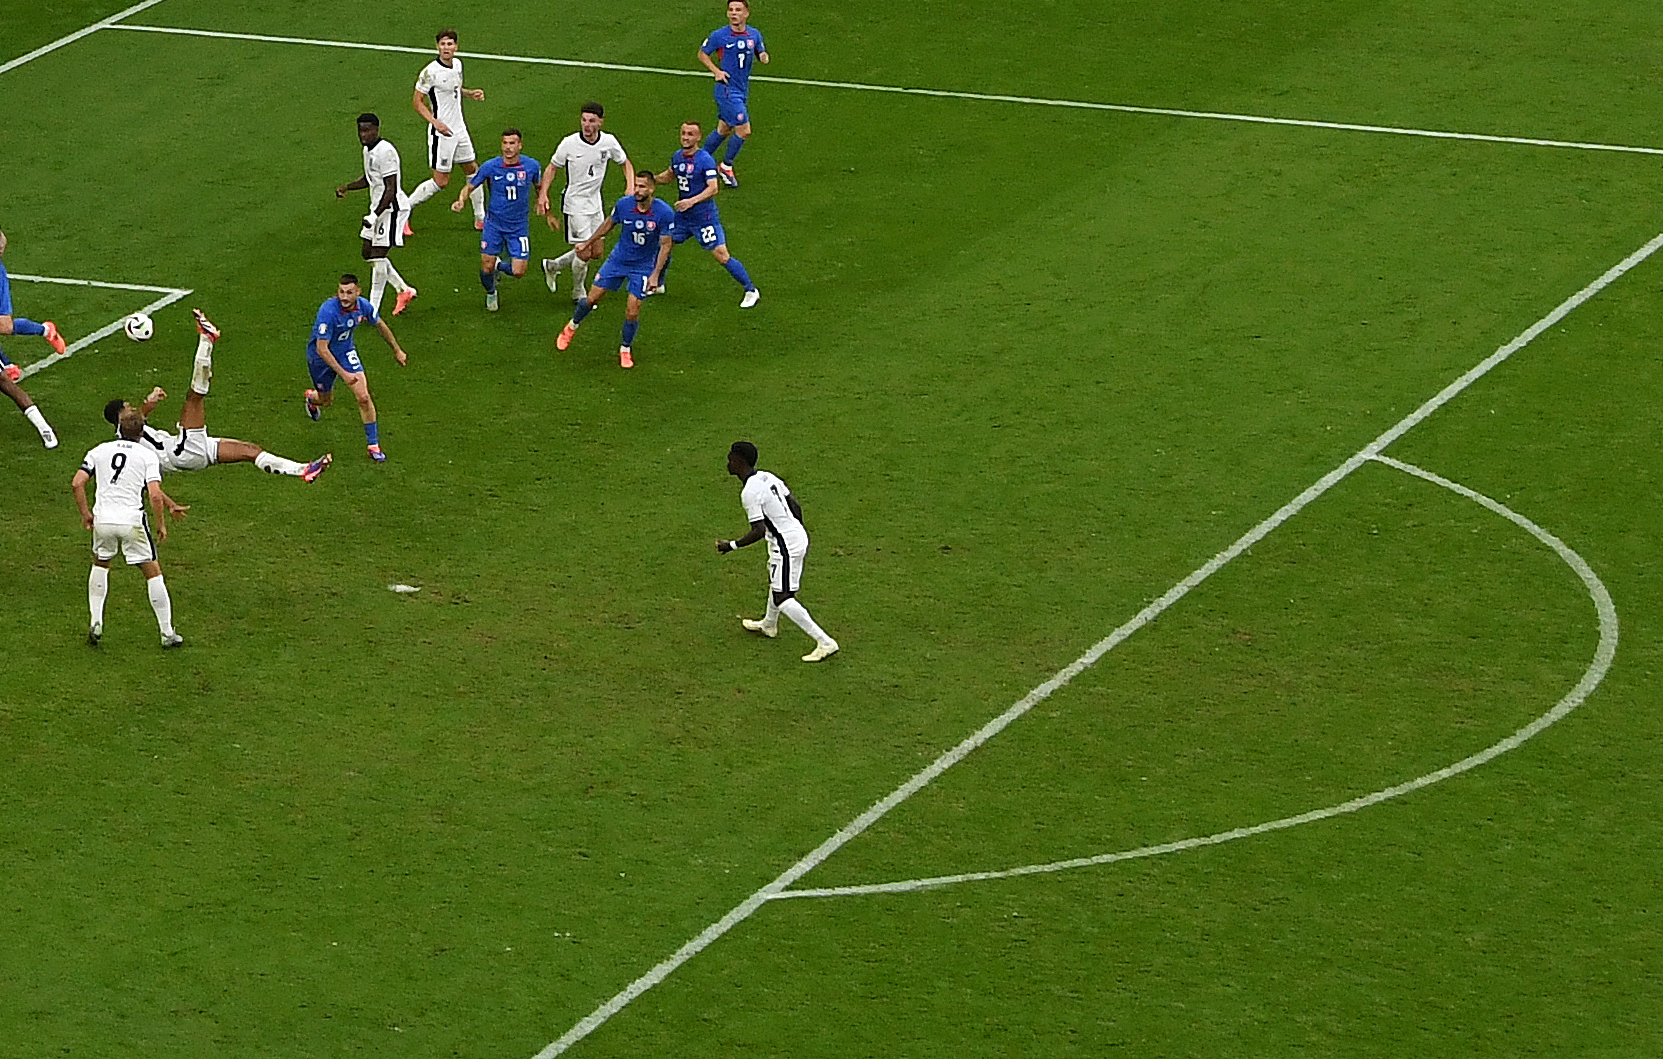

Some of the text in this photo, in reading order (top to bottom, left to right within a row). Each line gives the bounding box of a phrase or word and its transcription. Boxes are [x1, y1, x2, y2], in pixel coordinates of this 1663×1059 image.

[506, 186, 517, 200] 11
[701, 226, 717, 243] 22
[518, 237, 530, 252] 11
[110, 452, 127, 485] 9
[771, 564, 778, 578] 7
